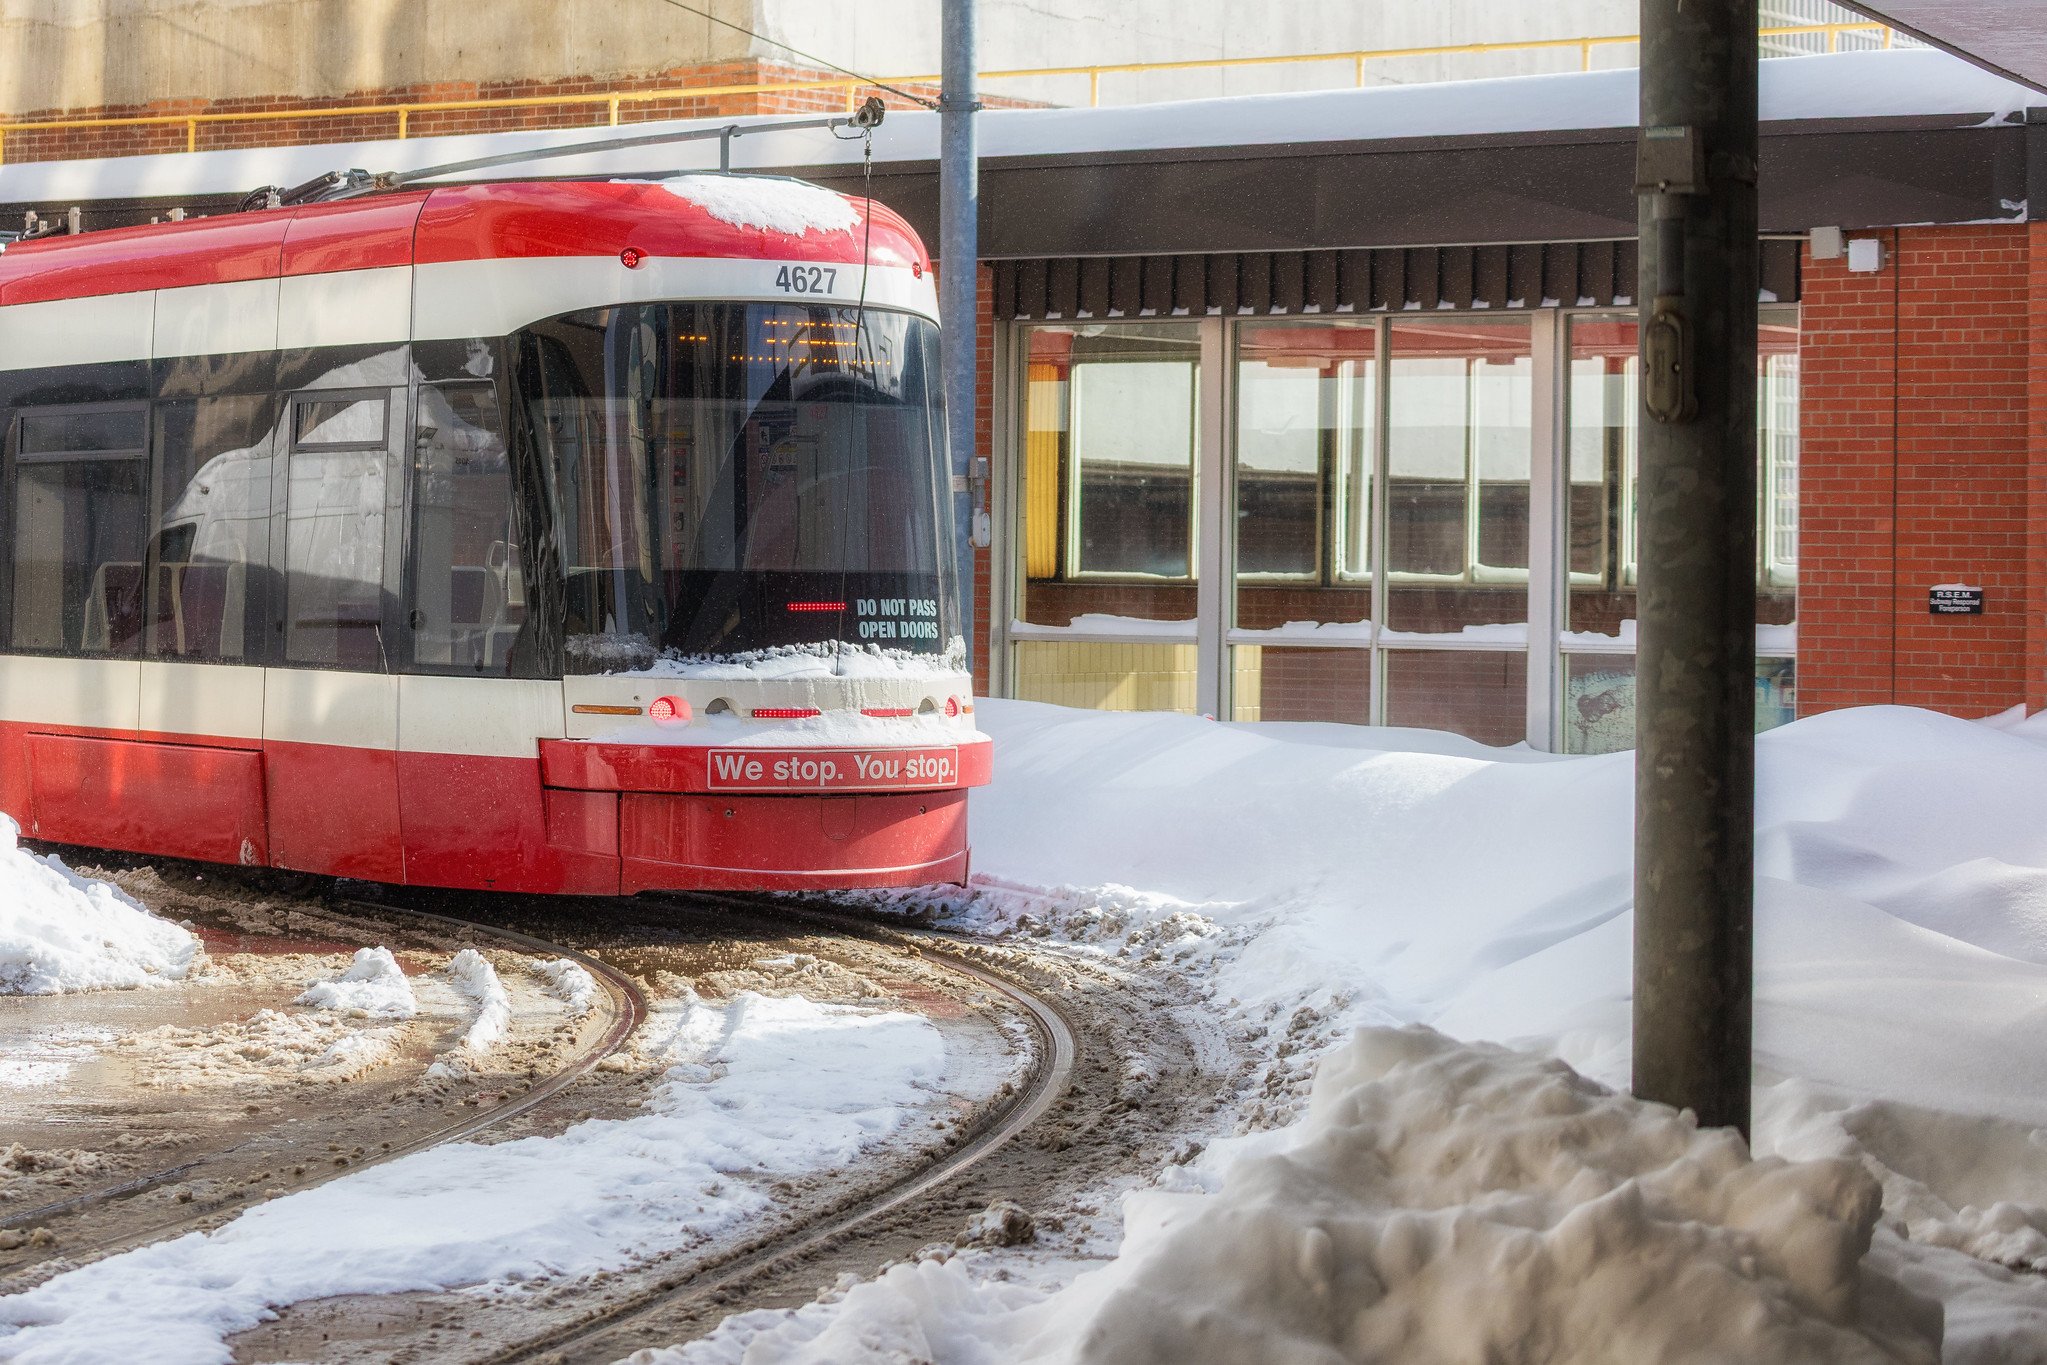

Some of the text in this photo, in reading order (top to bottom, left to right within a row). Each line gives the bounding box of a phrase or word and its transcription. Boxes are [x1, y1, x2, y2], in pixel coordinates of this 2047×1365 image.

[775, 265, 837, 294] 4627
[856, 598, 937, 617] DO NOT PASS
[859, 621, 938, 639] OPEN DOORS
[715, 754, 954, 786] We stop. You stop.
